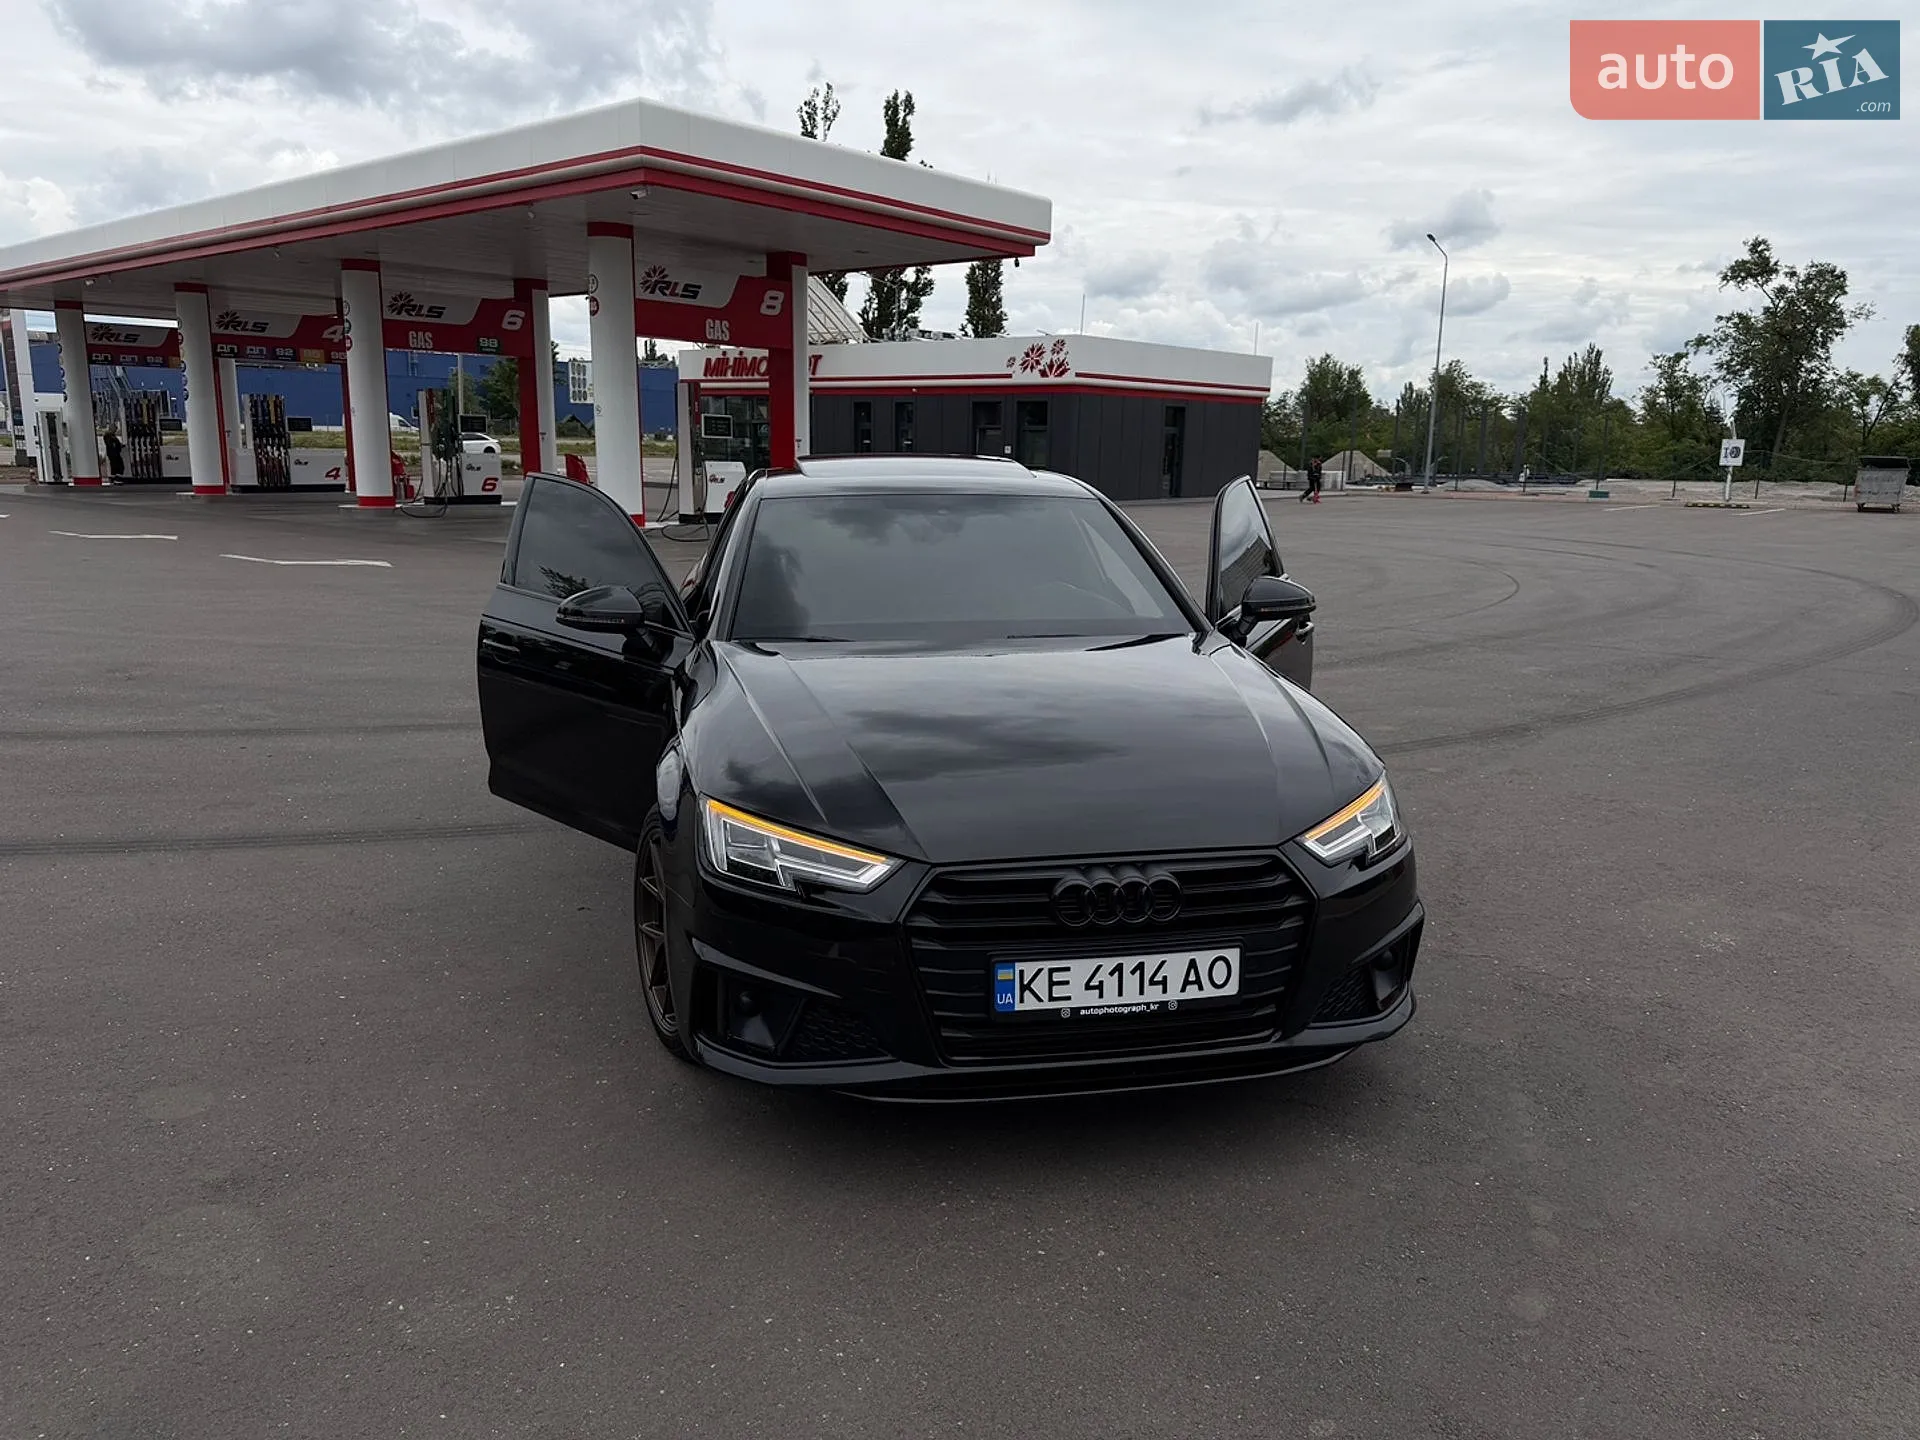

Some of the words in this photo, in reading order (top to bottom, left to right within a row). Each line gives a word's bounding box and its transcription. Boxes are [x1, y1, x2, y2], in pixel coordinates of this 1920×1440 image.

[649, 280, 702, 300] RLS
[398, 303, 448, 319] RLS
[760, 290, 785, 316] 8
[502, 309, 526, 331] 6
[321, 325, 345, 343] 4
[706, 318, 730, 342] GAS
[408, 331, 433, 349] GAS
[325, 467, 341, 480] 4
[481, 477, 499, 492] 6
[1018, 966, 1072, 1004] KE
[1084, 960, 1168, 999] 4114
[1180, 955, 1232, 993] AO
[997, 993, 1013, 1005] UA
[1080, 1003, 1160, 1015] autophotograph_kr
